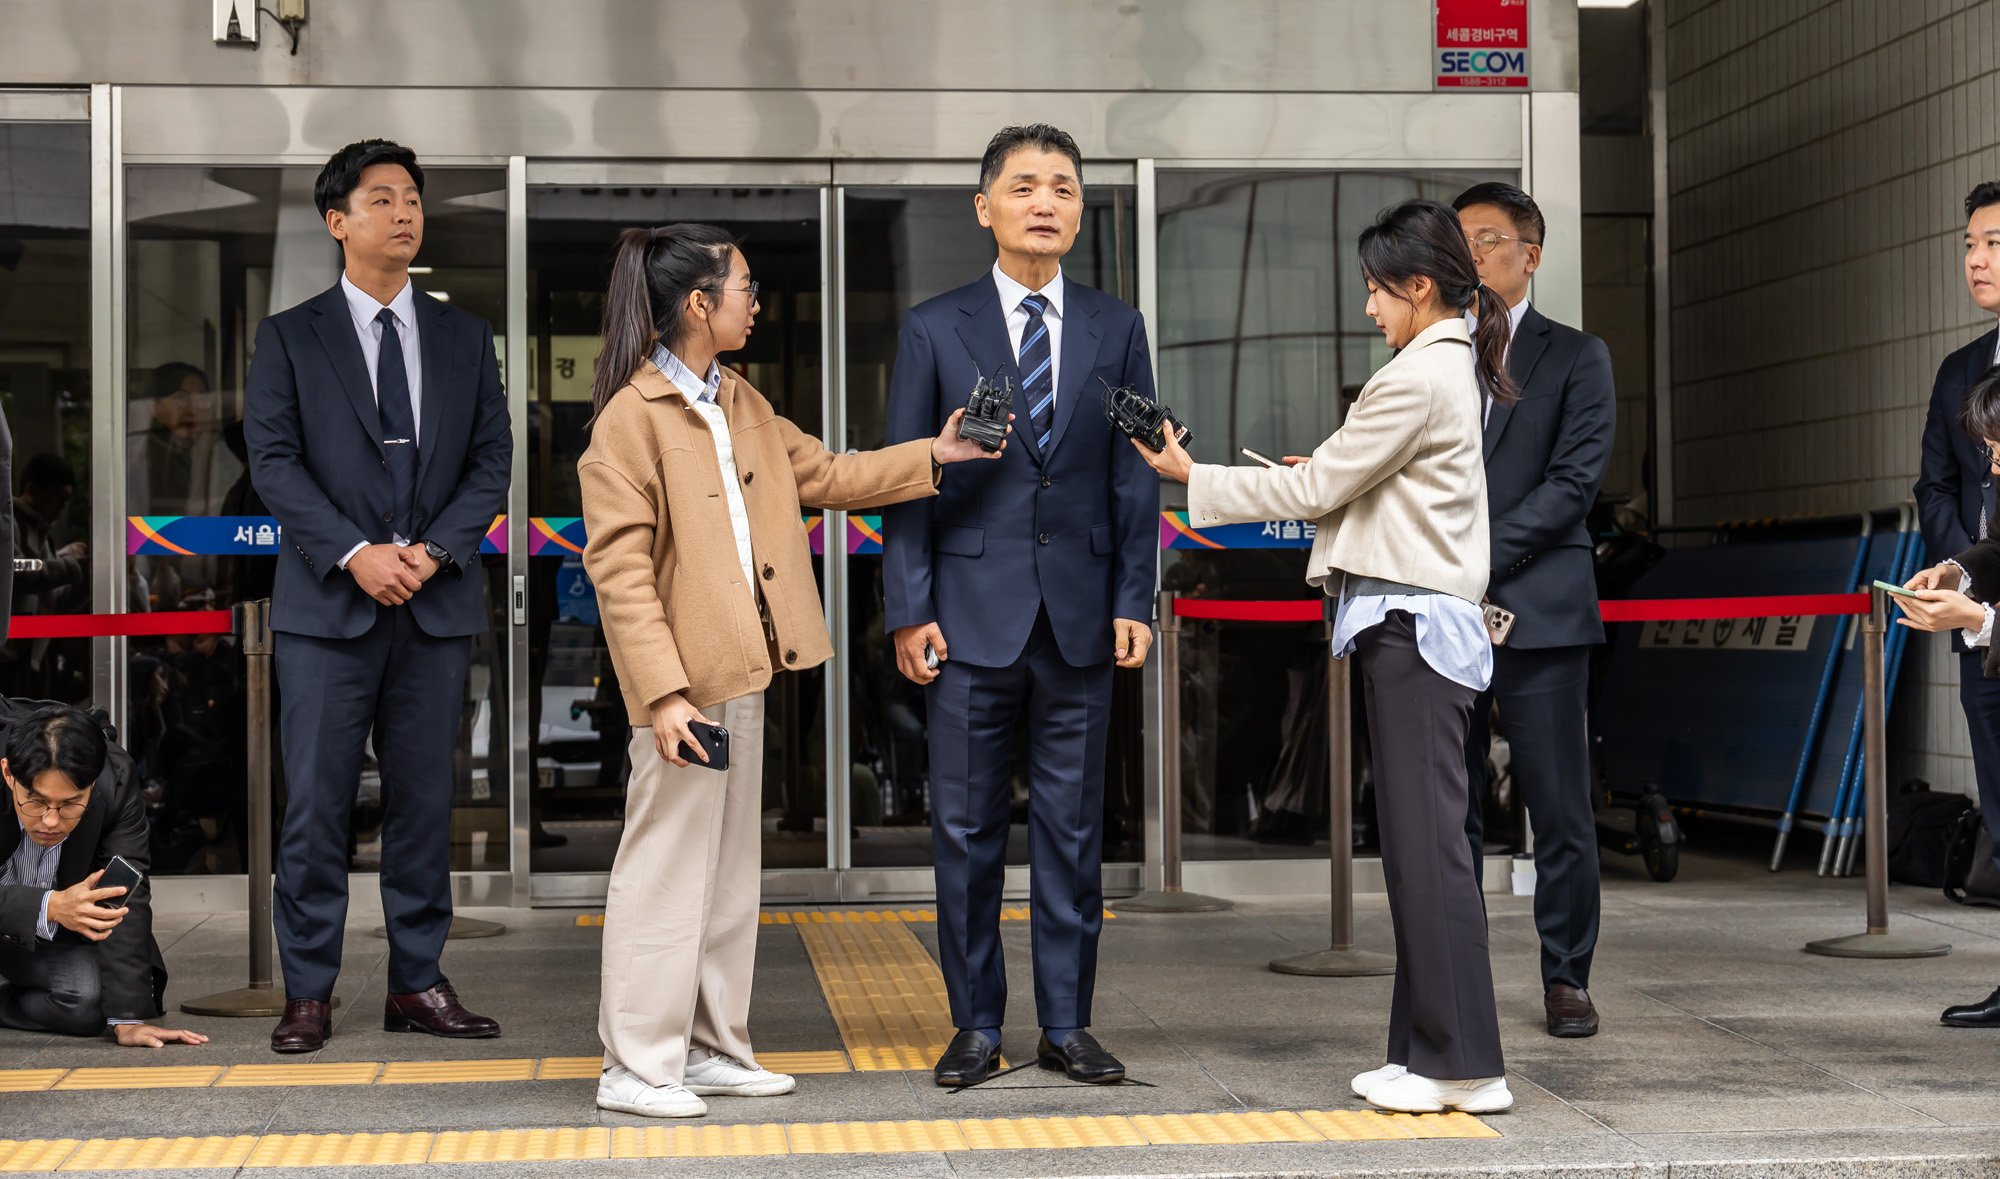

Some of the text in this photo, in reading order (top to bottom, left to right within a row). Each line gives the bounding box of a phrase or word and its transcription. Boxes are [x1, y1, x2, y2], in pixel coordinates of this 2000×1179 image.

[1446, 28, 1518, 42] 세콤경비구역
[1441, 51, 1524, 73] SECOM
[1459, 77, 1507, 87] 1588-3112
[233, 524, 281, 545] 서울
